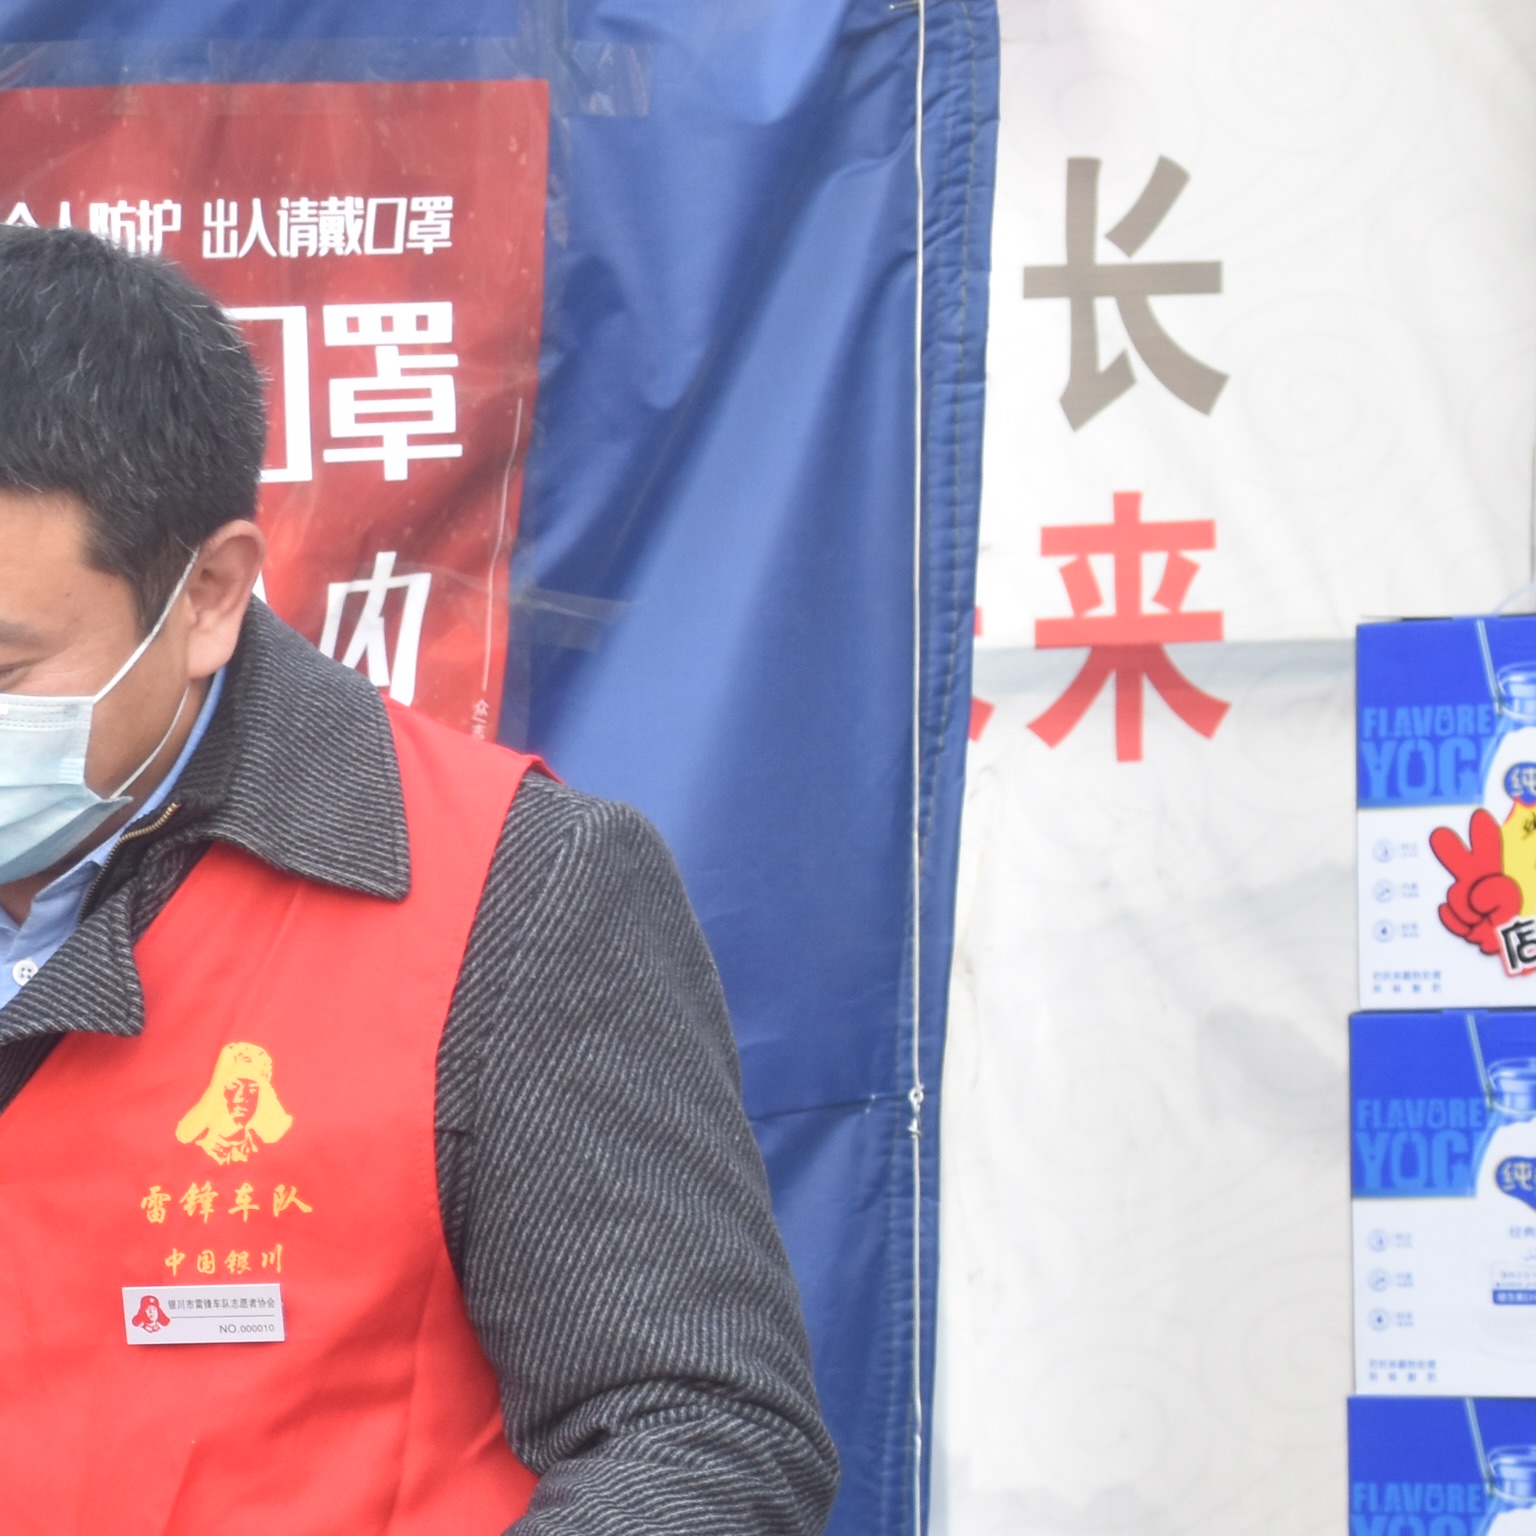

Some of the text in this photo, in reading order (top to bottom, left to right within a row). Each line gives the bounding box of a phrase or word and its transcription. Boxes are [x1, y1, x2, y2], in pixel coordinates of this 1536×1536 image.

[201, 195, 455, 259] 出入请戴口罩
[1022, 155, 1229, 432] 长
[256, 551, 431, 707] 内
[967, 490, 1232, 763] 来
[141, 1181, 313, 1224] 雷锋车队
[164, 1244, 284, 1276] 中国银川
[168, 1297, 275, 1310] 银川市雷锋车队志愿者协会
[219, 1323, 275, 1334] NO.000010
